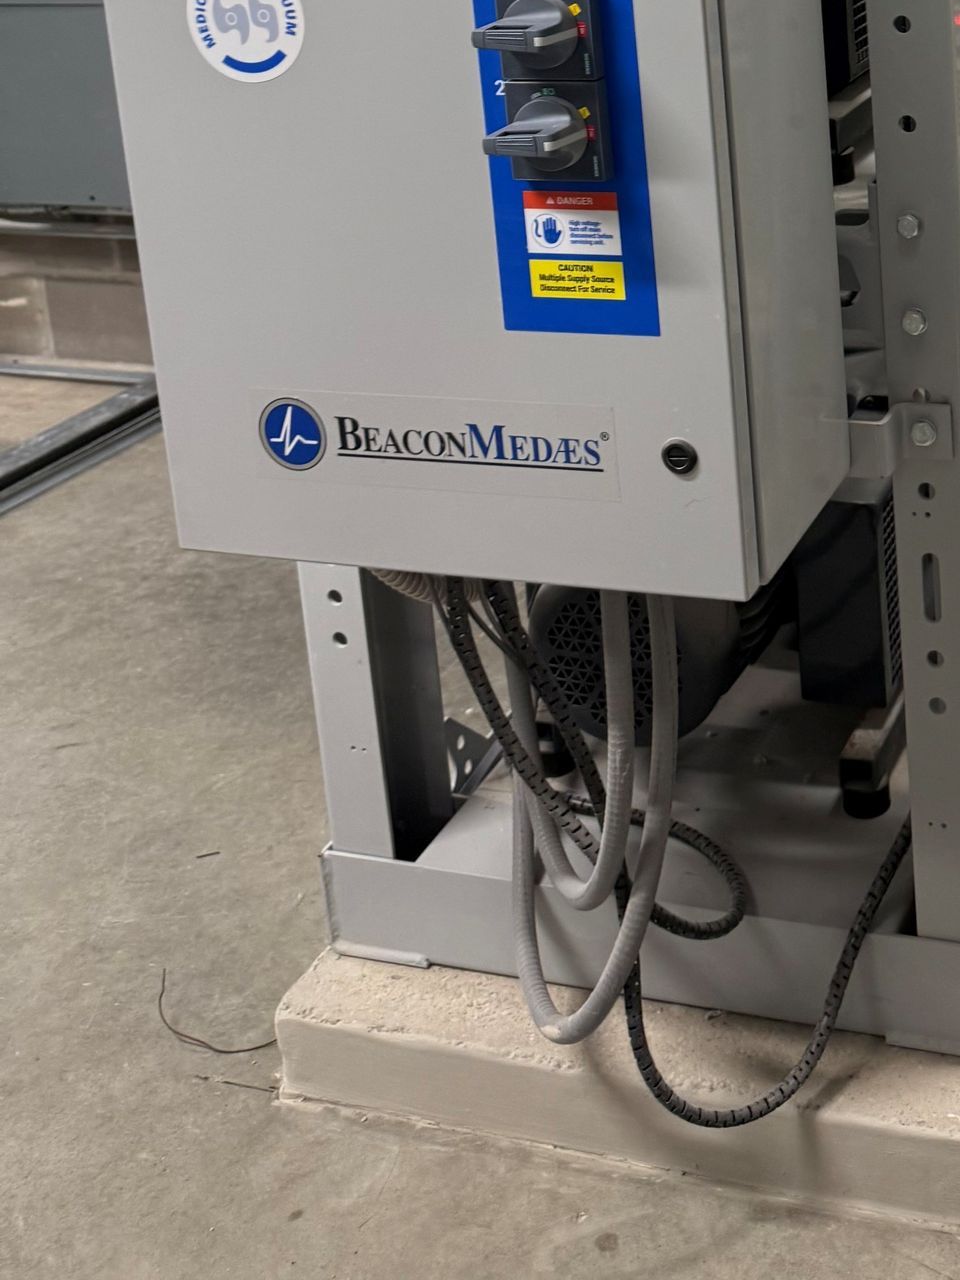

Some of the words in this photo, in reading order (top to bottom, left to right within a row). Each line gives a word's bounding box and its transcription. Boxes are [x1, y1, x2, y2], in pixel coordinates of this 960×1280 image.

[494, 79, 507, 96] 2
[556, 196, 593, 206] DANGER
[558, 264, 594, 272] CAUTION
[539, 273, 566, 282] Multiple
[566, 274, 590, 284] Supply
[591, 275, 615, 283] Source
[540, 283, 577, 293] Disconnect
[578, 285, 589, 293] For
[590, 285, 616, 294] Service
